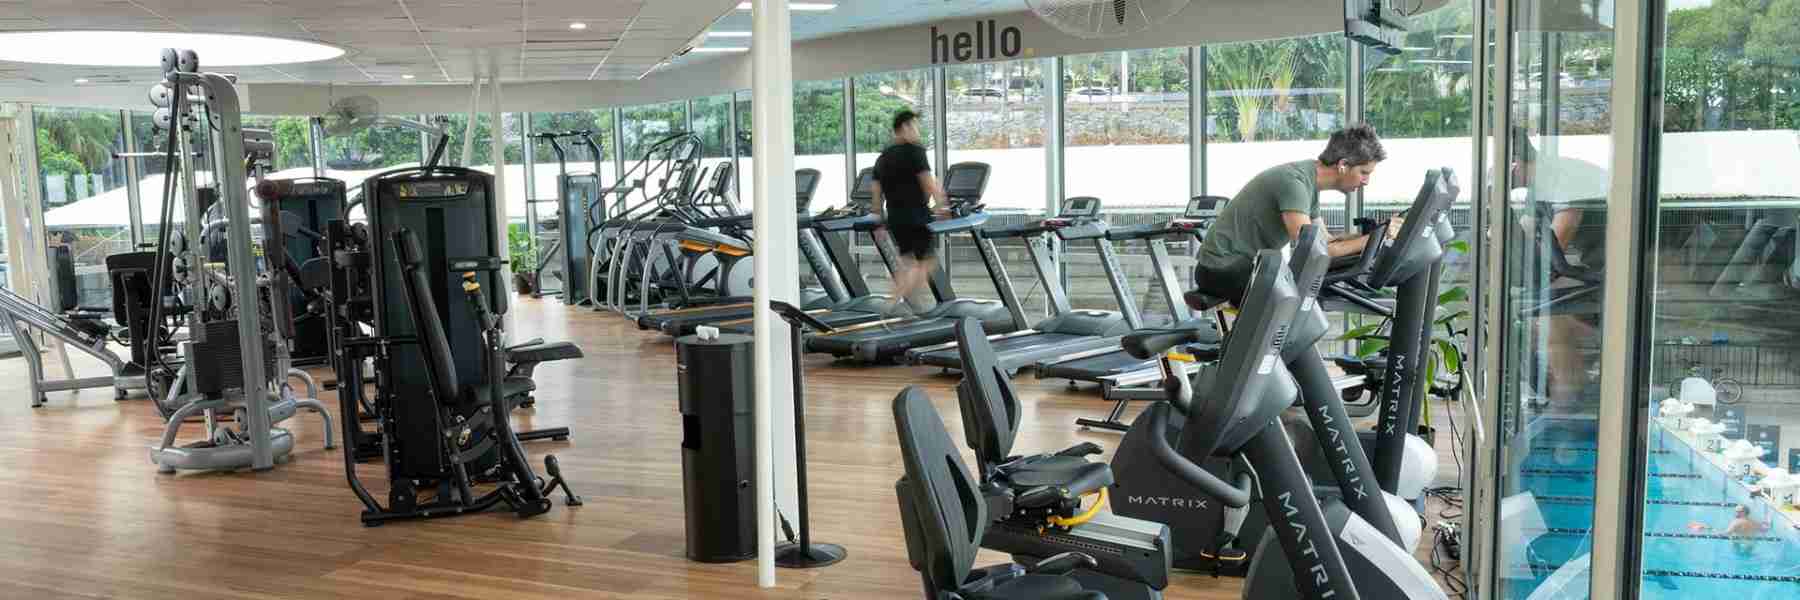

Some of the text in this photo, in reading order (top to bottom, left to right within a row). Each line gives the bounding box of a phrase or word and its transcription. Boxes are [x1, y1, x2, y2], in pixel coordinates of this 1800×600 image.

[1385, 355, 1406, 436] MATRIX
[1318, 405, 1368, 499] MATRIX
[1128, 495, 1208, 510] MATRIX
[1278, 491, 1335, 600] MATRI
